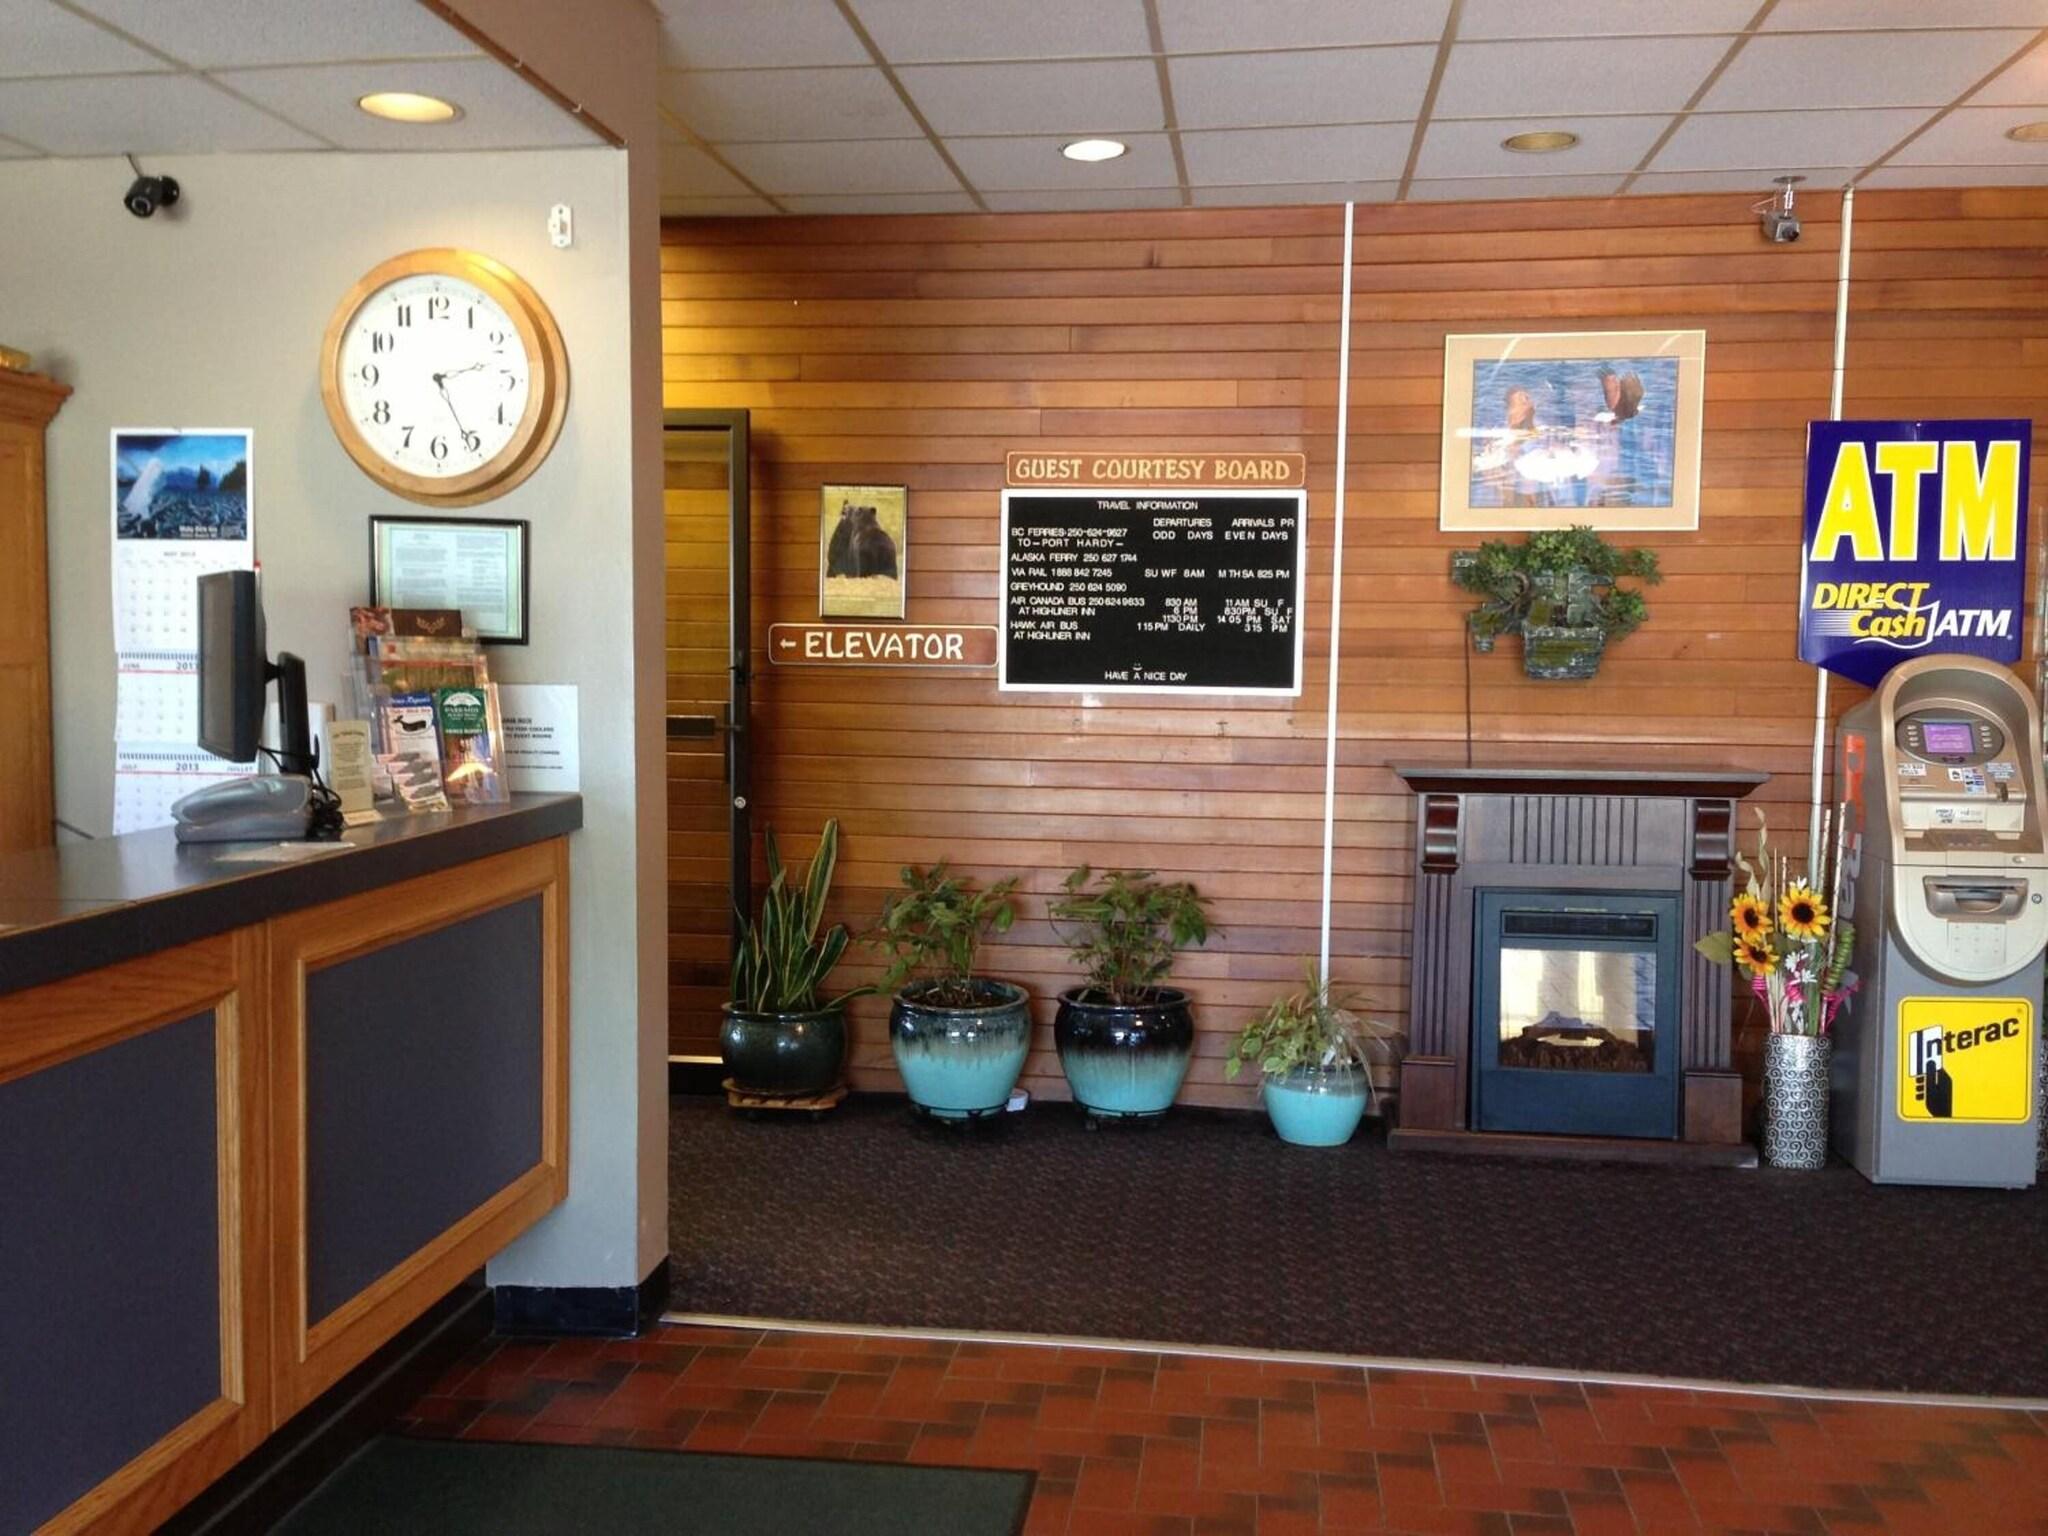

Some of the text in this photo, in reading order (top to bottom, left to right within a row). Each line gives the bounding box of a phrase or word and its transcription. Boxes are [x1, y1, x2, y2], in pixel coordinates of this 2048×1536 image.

[428, 295, 451, 321] 12
[397, 304, 412, 328] 11
[467, 305, 474, 330] 1
[372, 330, 395, 354] 10
[488, 330, 505, 355] 2
[360, 362, 380, 388] 9
[372, 399, 391, 425] 8
[400, 425, 415, 449] 7
[463, 429, 482, 453] 5
[429, 433, 449, 460] 6
[1015, 458, 1291, 481] GUEST COURTESY BOARD
[1097, 500, 1198, 510] TRAVEL INFORMATION
[1808, 440, 2021, 562] ATM
[1153, 518, 1212, 528] DEPARTURES
[1231, 518, 1295, 528] ARRIVALS PR
[1011, 528, 1025, 538] BC
[1152, 531, 1214, 540] ODD DAYS
[1224, 531, 1289, 540] EVEN DAYS
[1010, 553, 1046, 562] ALASKA
[1049, 553, 1079, 562] FERRY
[1011, 568, 1026, 577] VIA
[1028, 568, 1047, 577] RAIL
[1275, 569, 1290, 579] PM
[1009, 582, 1065, 592] GREYHOUND
[1010, 596, 1026, 606] AIR
[1029, 596, 1065, 606] CANADA
[1067, 596, 1086, 606] BUS
[1811, 582, 1930, 610] DIRECT
[1183, 598, 1198, 607] AM
[1254, 598, 1268, 608] SU
[1018, 606, 1096, 616] AT HIGHLINER INN
[1183, 607, 1198, 616] PM
[1264, 608, 1279, 616] SU
[1183, 614, 1199, 624] PM
[1246, 615, 1262, 624] PM
[1270, 615, 1292, 624] SAT
[1850, 608, 2012, 639] Cash ATM
[1009, 621, 1079, 630] HAWK AIR BUS
[1178, 623, 1206, 632] DAILY
[1271, 624, 1288, 633] PM
[1013, 632, 1091, 640] AT HIGHLINER INN
[804, 631, 964, 660] ELEVATOR
[1104, 671, 1188, 680] HAVE A NICE DAY
